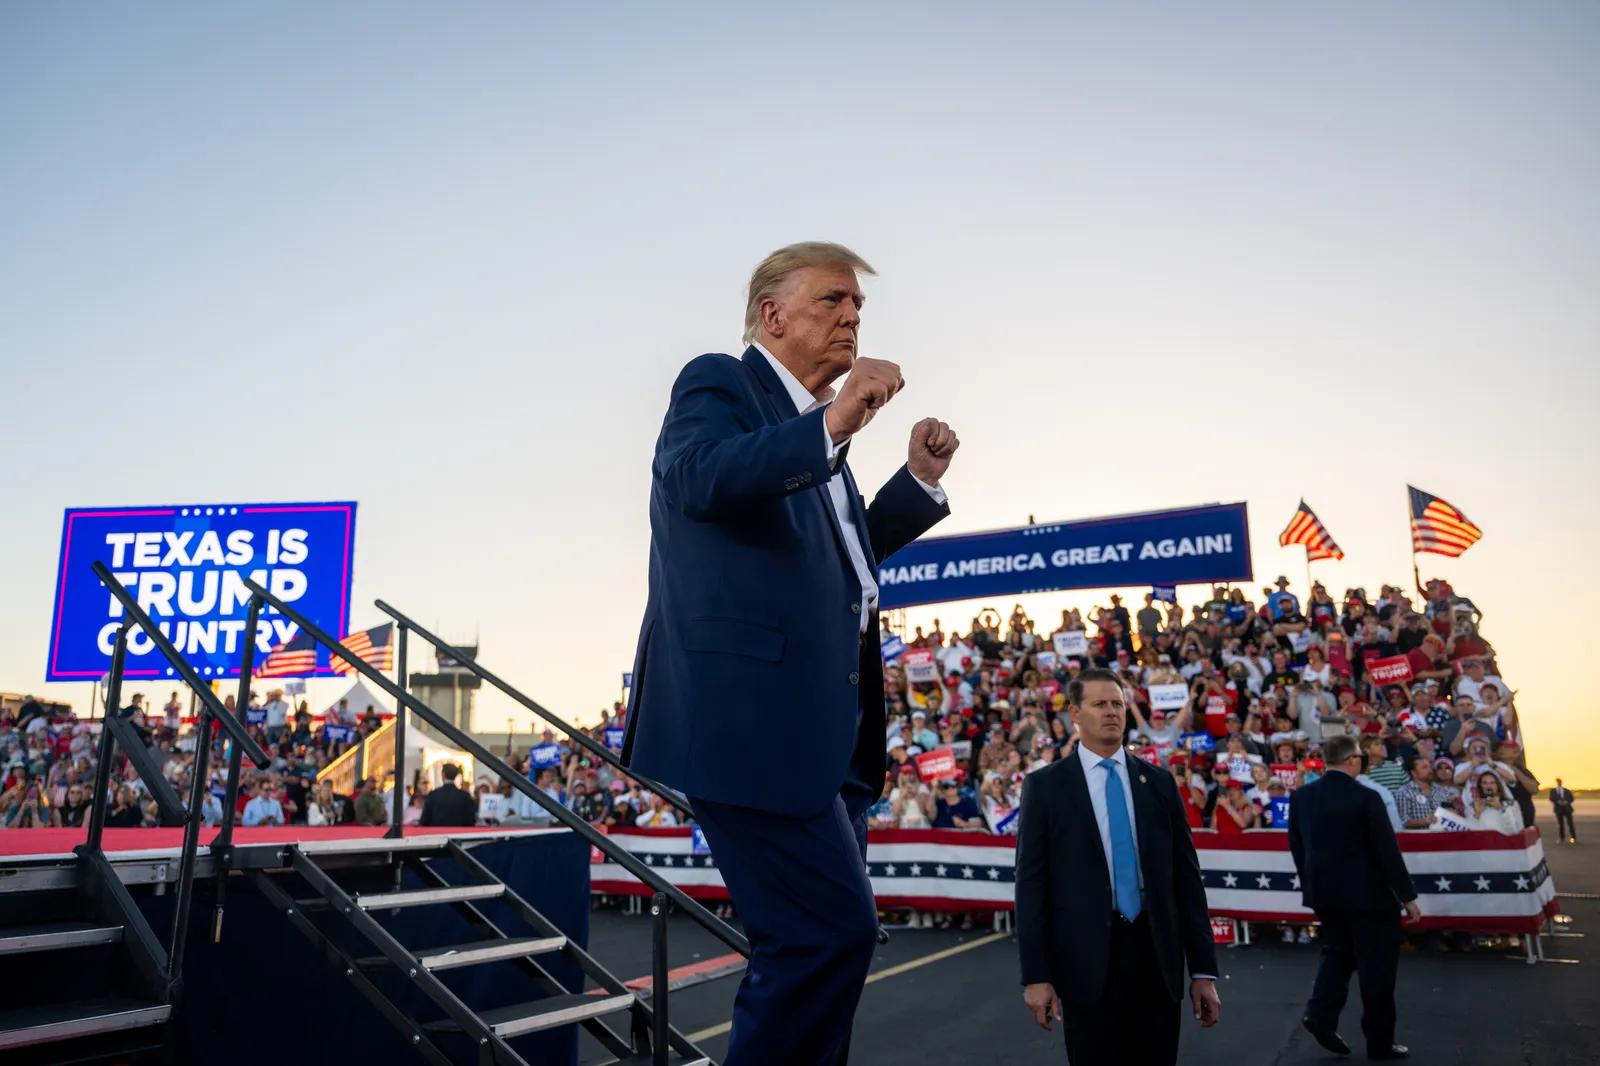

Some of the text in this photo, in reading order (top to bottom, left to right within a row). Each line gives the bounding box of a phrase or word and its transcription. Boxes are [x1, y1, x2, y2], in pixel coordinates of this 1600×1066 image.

[105, 528, 309, 568] TEXAS IS
[879, 533, 1233, 586] MAKE AMERICA GREAT AGAIN!
[101, 568, 308, 618] TRUMP
[97, 619, 300, 656] COUNTRY
[1440, 816, 1471, 832] TRU
